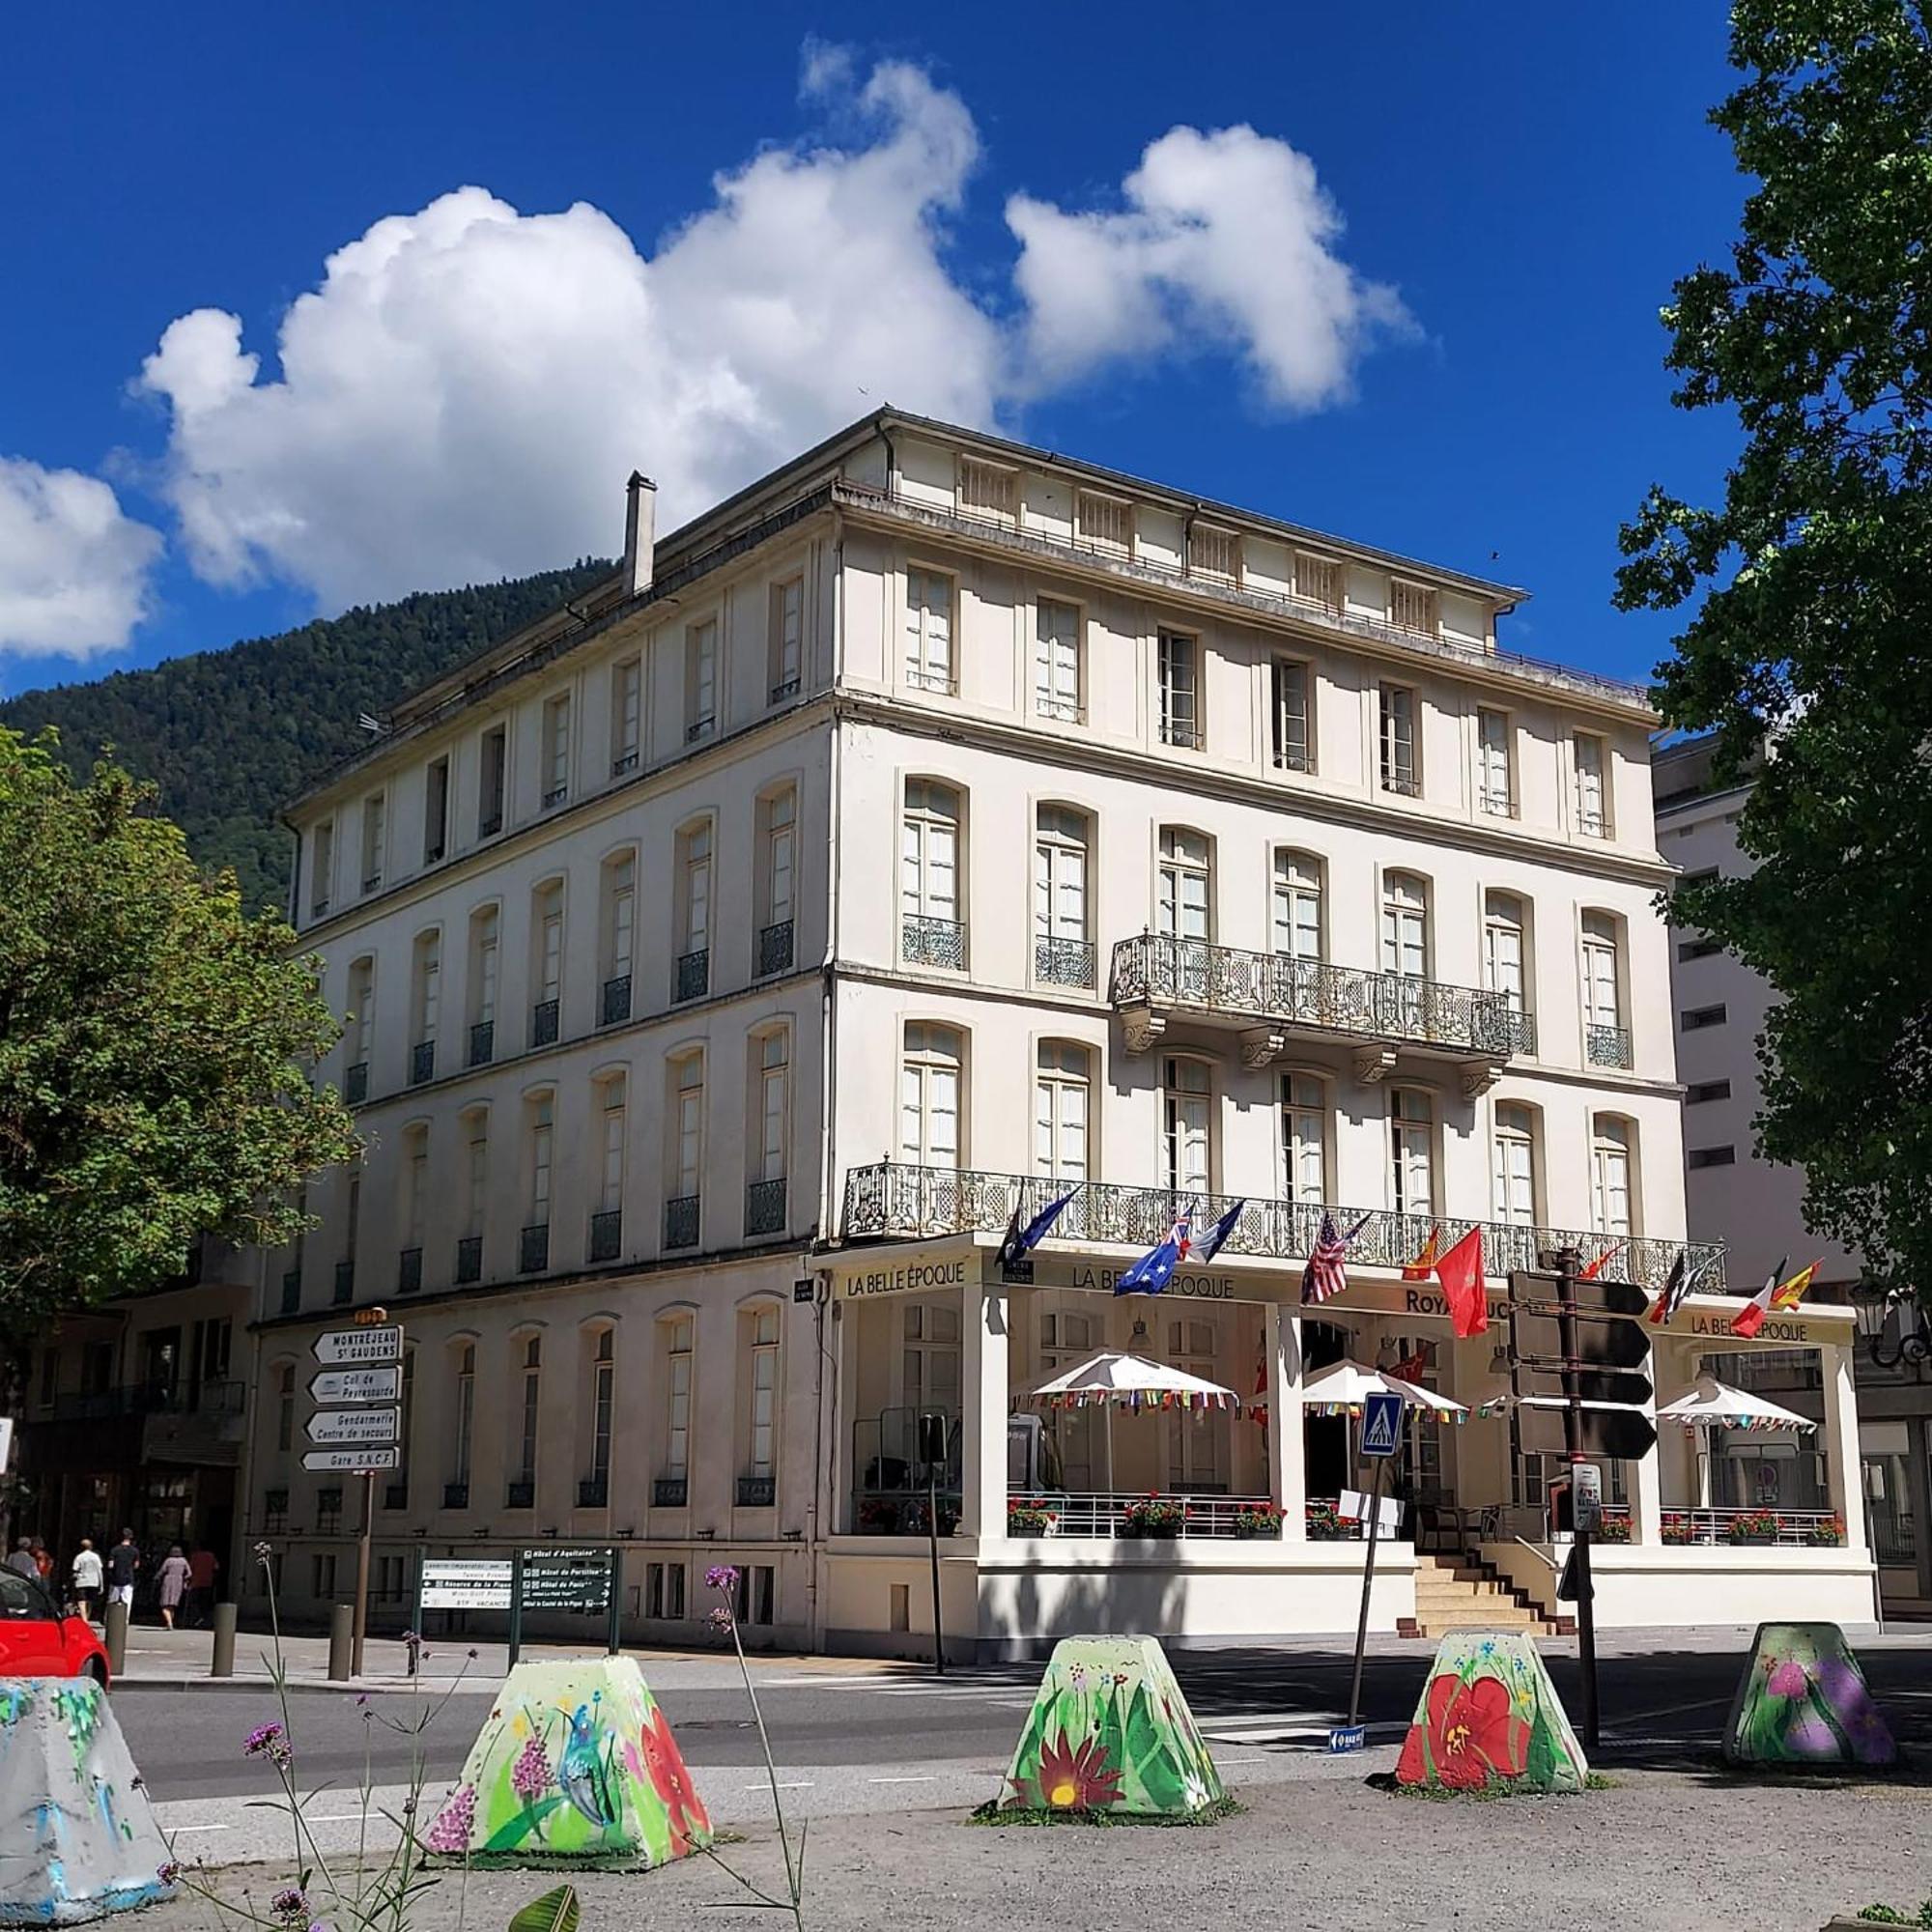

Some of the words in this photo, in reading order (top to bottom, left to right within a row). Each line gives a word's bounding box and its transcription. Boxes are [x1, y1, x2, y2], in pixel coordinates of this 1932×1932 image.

[847, 1277, 865, 1296] LA
[867, 1270, 903, 1293] BELLE
[907, 1263, 964, 1289] ÉPOQUE
[1073, 1267, 1094, 1288] LA
[1163, 1274, 1235, 1298] POQUE
[1691, 1316, 1708, 1334] LA
[1712, 1319, 1736, 1336] BEL
[1758, 1321, 1807, 1341] POQUE
[333, 1331, 396, 1346] MONTRÉJEAU
[352, 1346, 395, 1359] GAUDENS
[343, 1375, 358, 1385] Col
[363, 1373, 374, 1384] de
[342, 1386, 394, 1399] Peyresourde
[338, 1412, 393, 1426] Gendarmerie
[317, 1429, 343, 1439] Centre
[348, 1428, 357, 1438] de
[361, 1428, 392, 1438] secours
[330, 1455, 352, 1466] Gare
[532, 1549, 552, 1558] Hôtel
